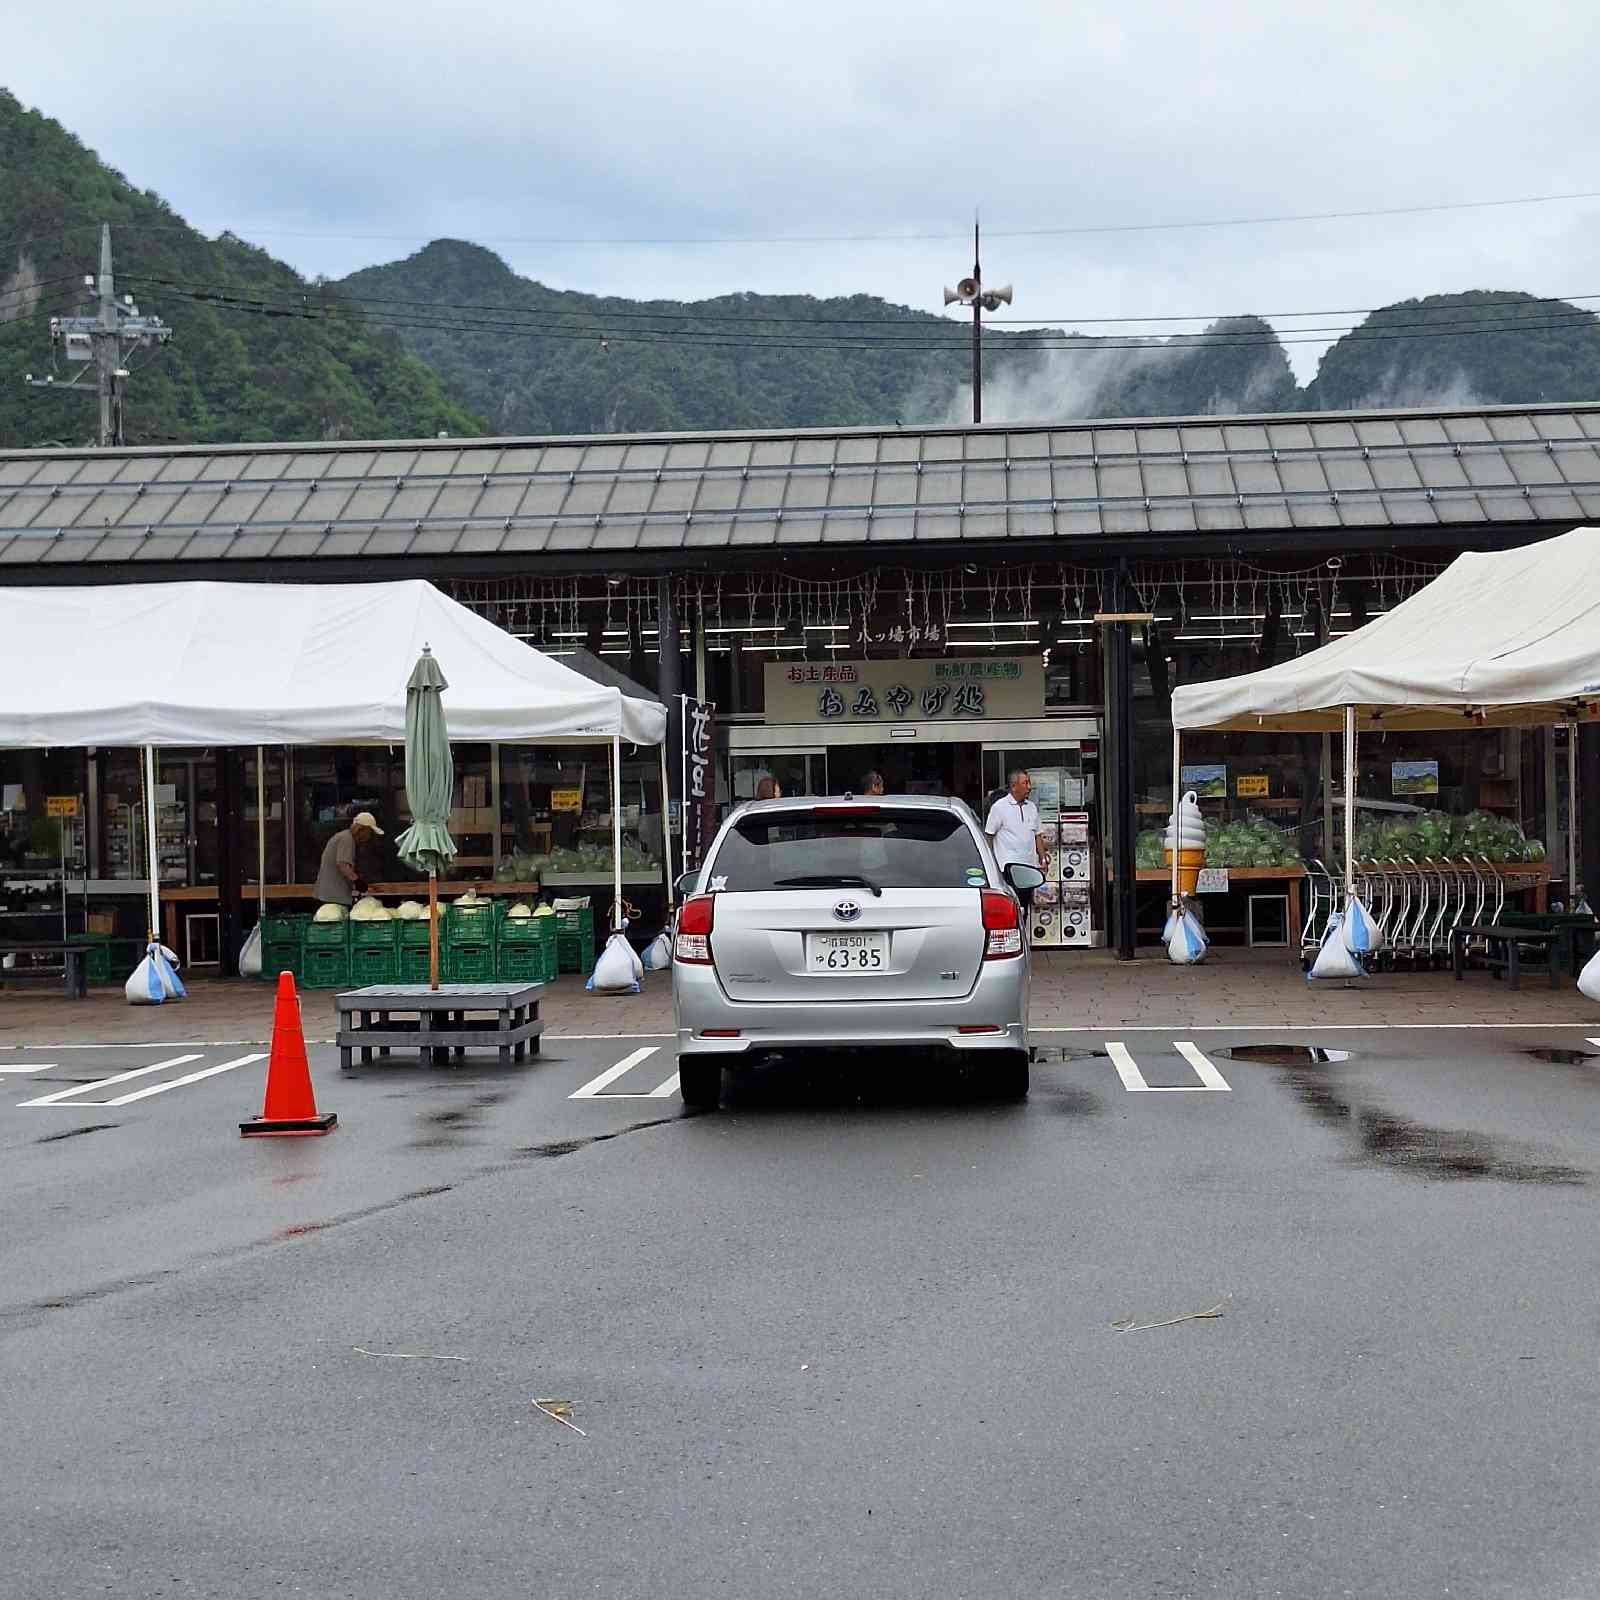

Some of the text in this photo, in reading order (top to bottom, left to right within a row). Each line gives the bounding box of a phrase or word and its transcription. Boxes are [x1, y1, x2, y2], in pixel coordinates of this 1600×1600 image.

[856, 623, 941, 644] 八ッ場市場
[786, 665, 858, 684] お土産品
[819, 682, 985, 718] おみやげ処
[827, 949, 881, 968] 63-85
